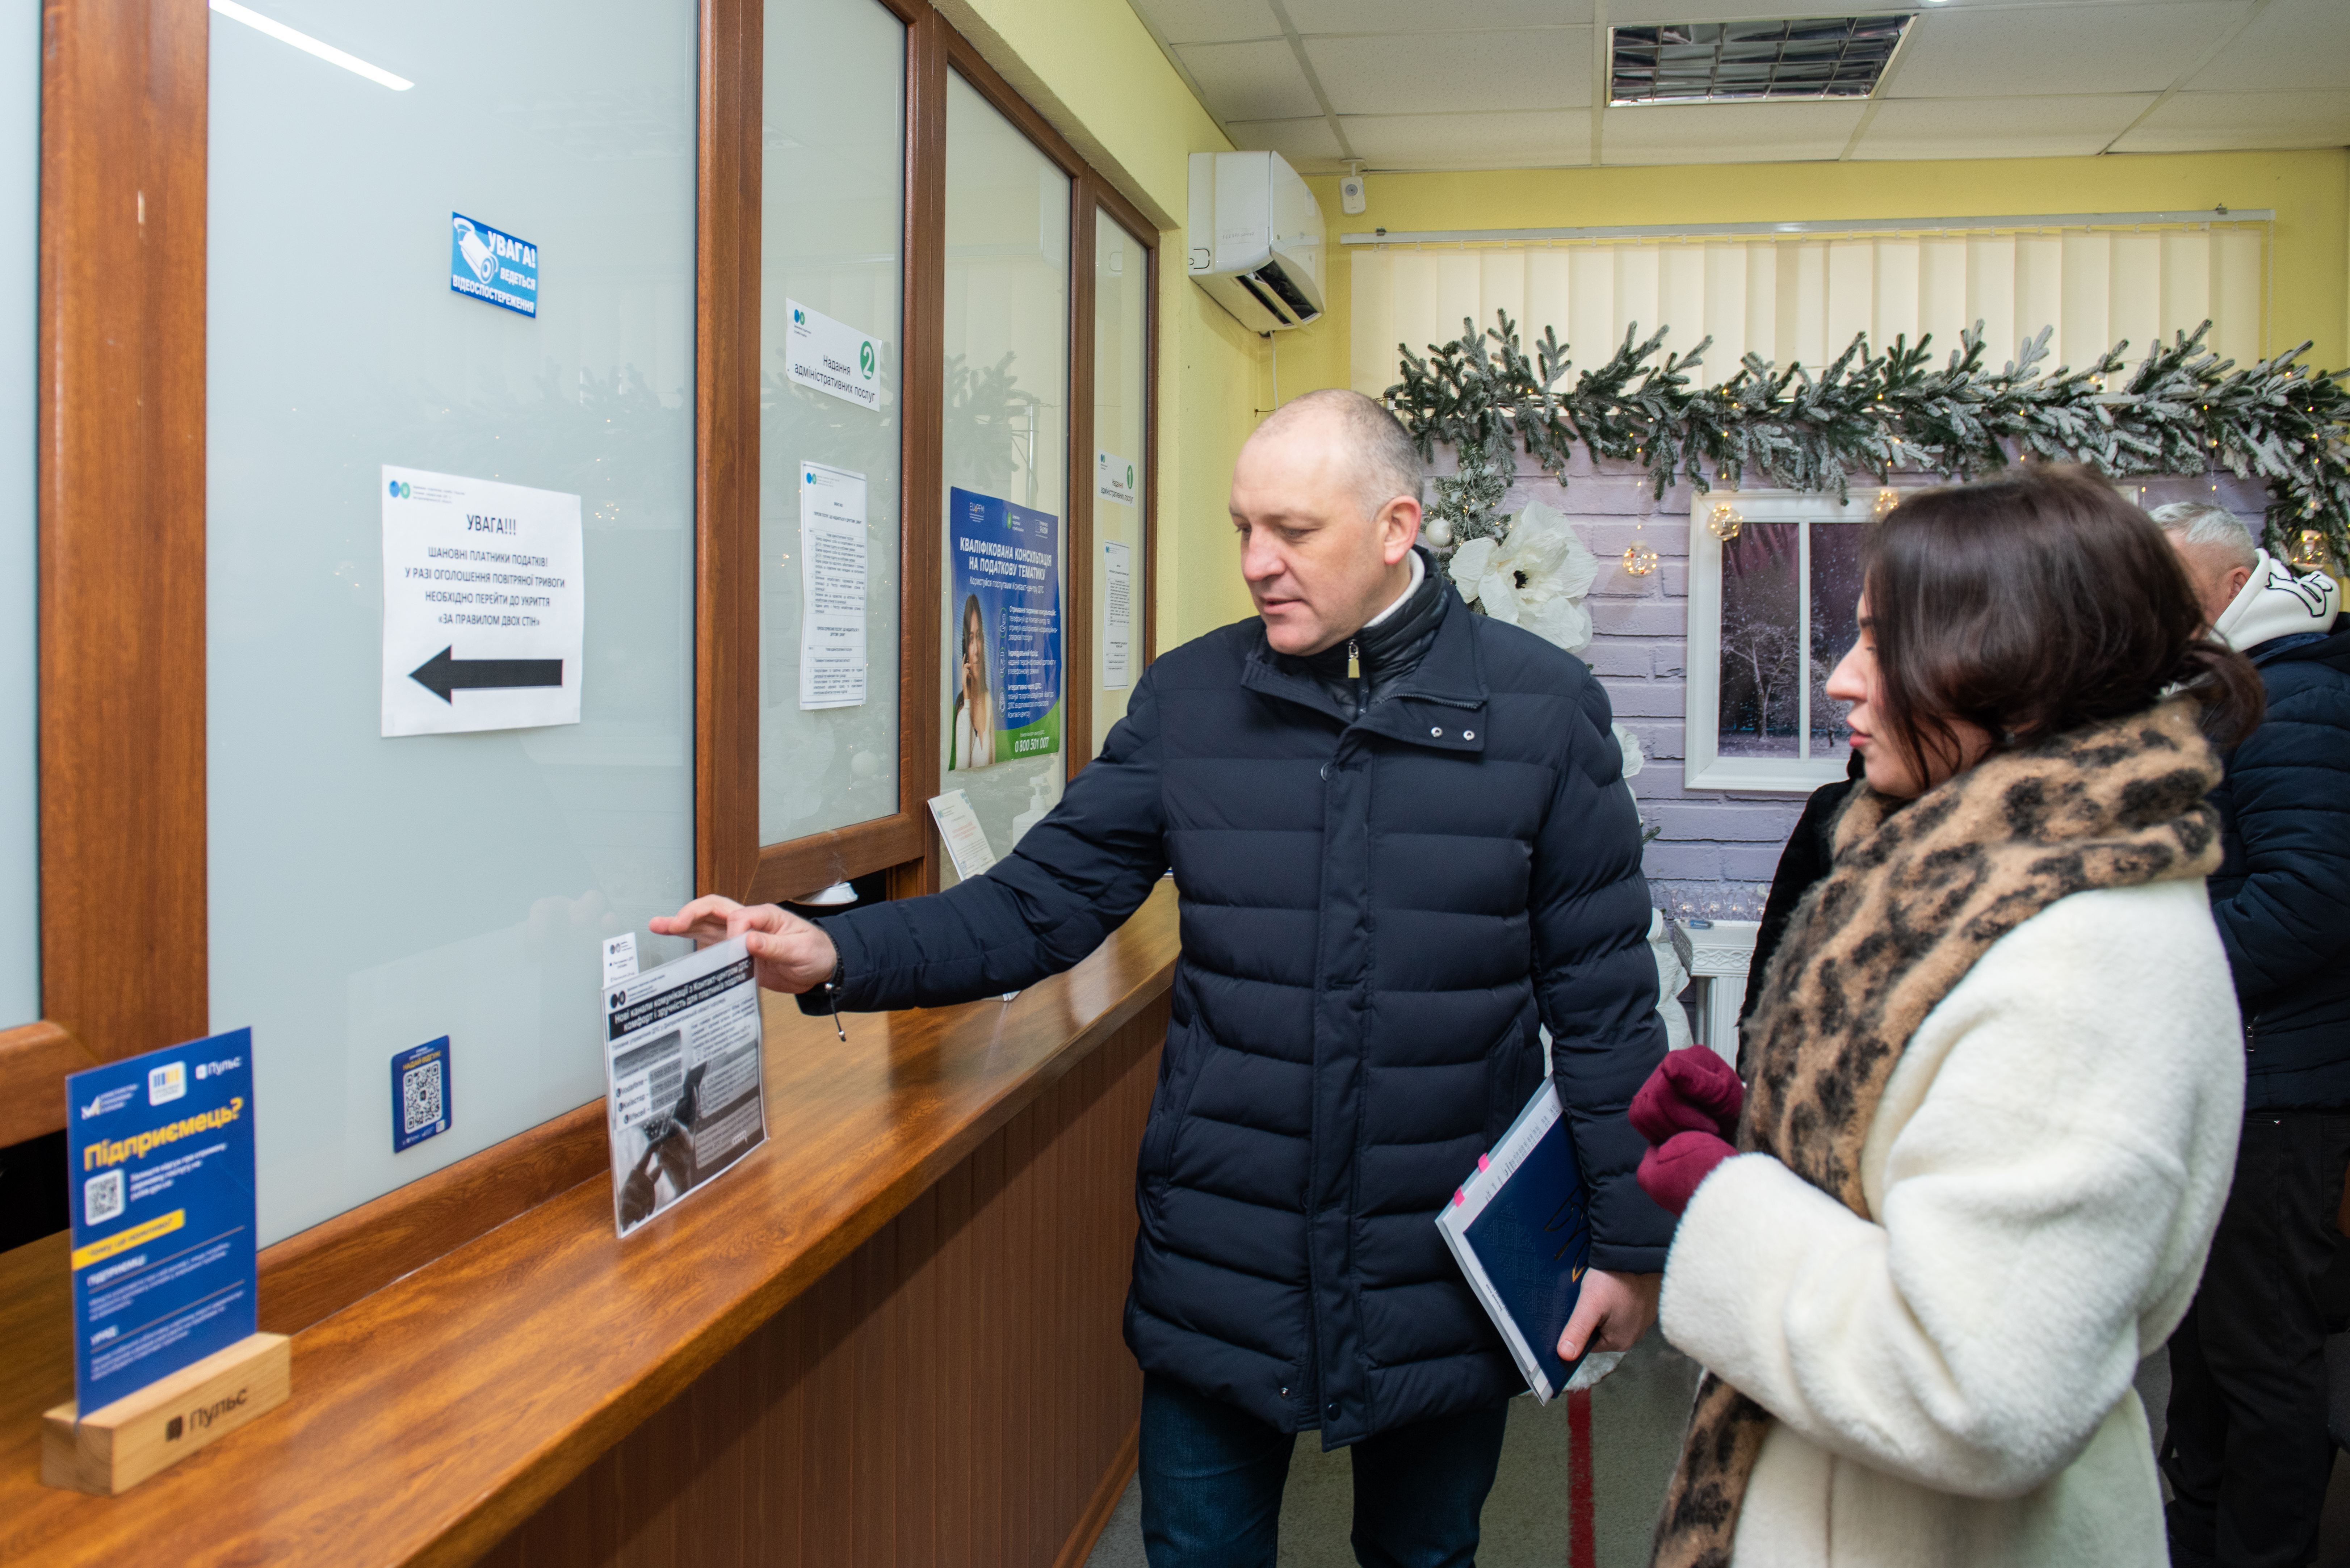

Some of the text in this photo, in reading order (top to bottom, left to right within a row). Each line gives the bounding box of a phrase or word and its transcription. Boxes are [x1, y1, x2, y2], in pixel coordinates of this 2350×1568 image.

[488, 231, 535, 268] УВАГА!
[500, 267, 535, 291] ВЕДЕТЬСЯ
[453, 274, 534, 313] ВІДЕОСПОСТЕРЕЖЕННЯ
[823, 354, 850, 376] Надання
[863, 346, 872, 377] 2
[795, 364, 875, 403] адміністративних послуг
[467, 514, 516, 535] УВАГА!!!
[428, 546, 548, 567] ШАНОВНІ ПЛАТНИКИ ПОДАТКІВ!
[960, 536, 1052, 569] КВАЛІФІКОВАНА КОНСУЛЬТАЦІЯ
[405, 567, 565, 588] У РАЗІ ОГОЛОШЕННЯ ПОВІТРЯНОЇ ТРИВОГИ
[969, 555, 1045, 581] НА ПОДАТКОВУ ТЕМАТИКУ
[969, 576, 991, 589] Користуйся
[425, 591, 550, 607] НЕОБХІДНО ПЕРЕЙТИ ДО УКРИТТЯ
[456, 614, 499, 625] ПРАВИЛОМ
[502, 616, 520, 627] ДВОХ
[1015, 736, 1049, 753] 0 800 501 007
[614, 1009, 629, 1025] Нові
[630, 1001, 652, 1018] канали
[624, 1012, 652, 1034] комфорт
[84, 1097, 243, 1171] Підприємець?
[189, 1387, 248, 1432] Пульс
